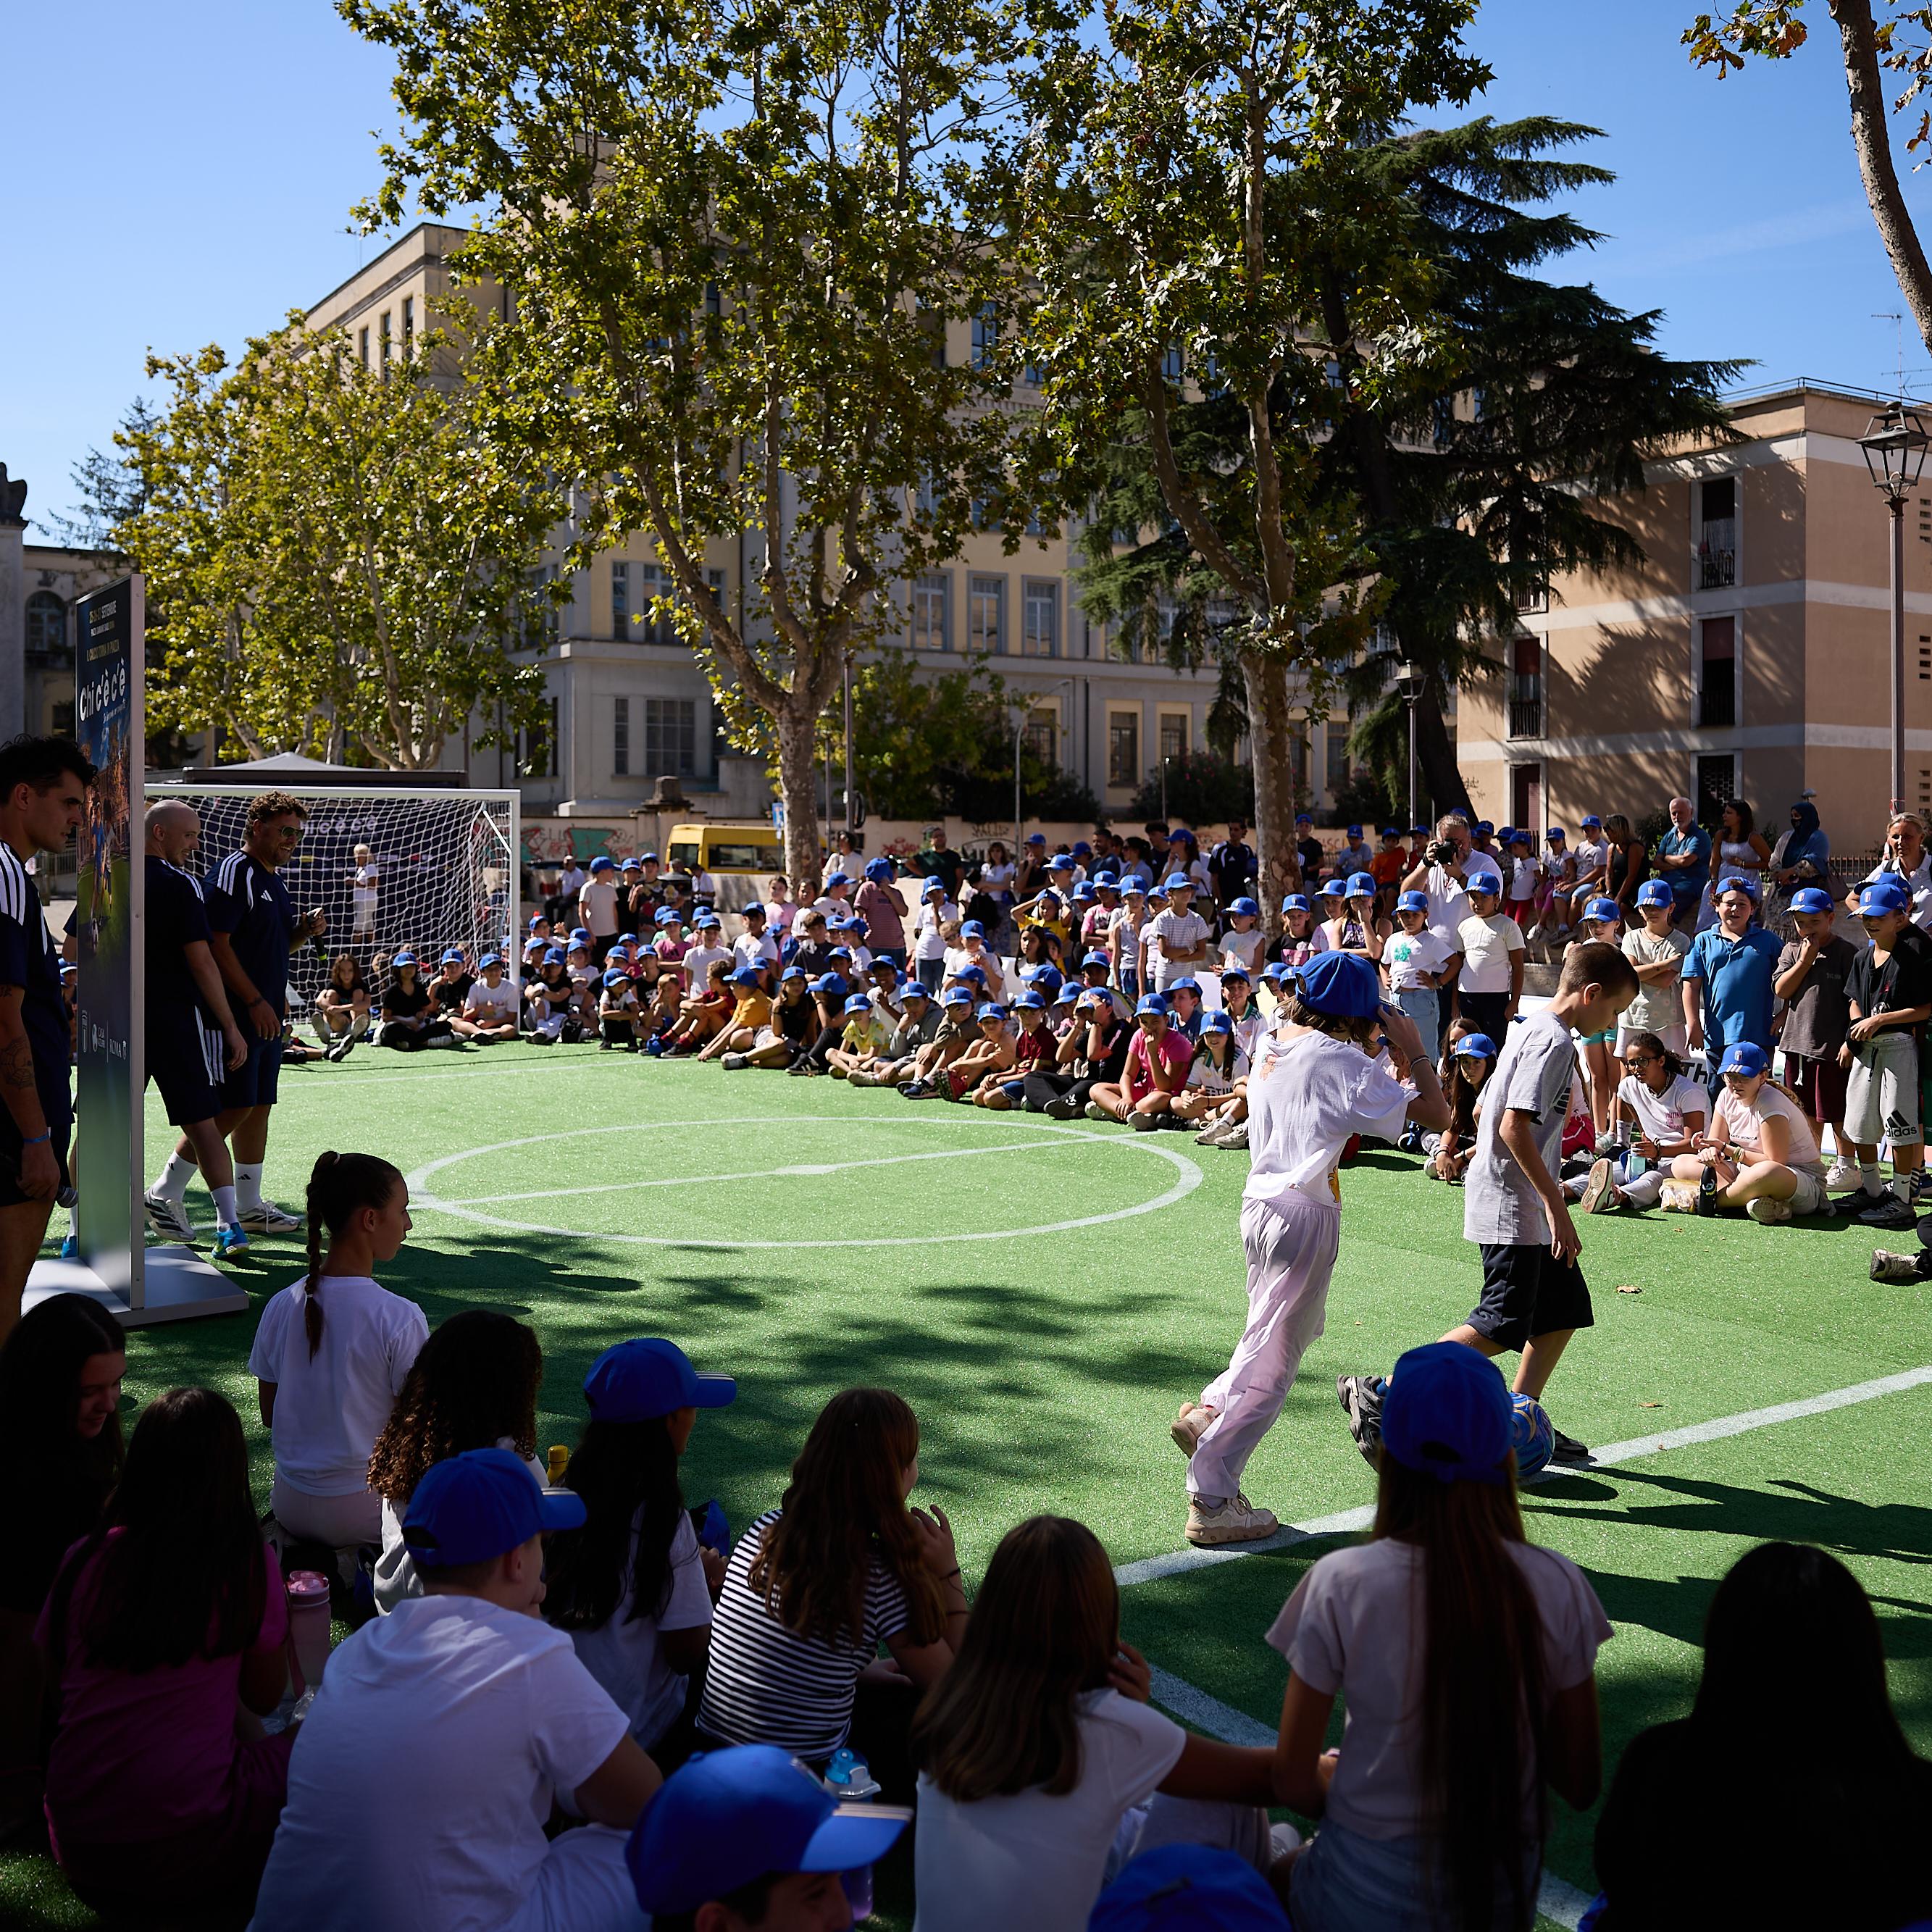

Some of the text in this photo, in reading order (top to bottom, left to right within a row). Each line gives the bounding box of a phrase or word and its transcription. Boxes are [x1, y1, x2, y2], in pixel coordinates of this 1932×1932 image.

[80, 681, 94, 721] Chi
[96, 668, 109, 711] c'è
[112, 656, 125, 702] c'è
